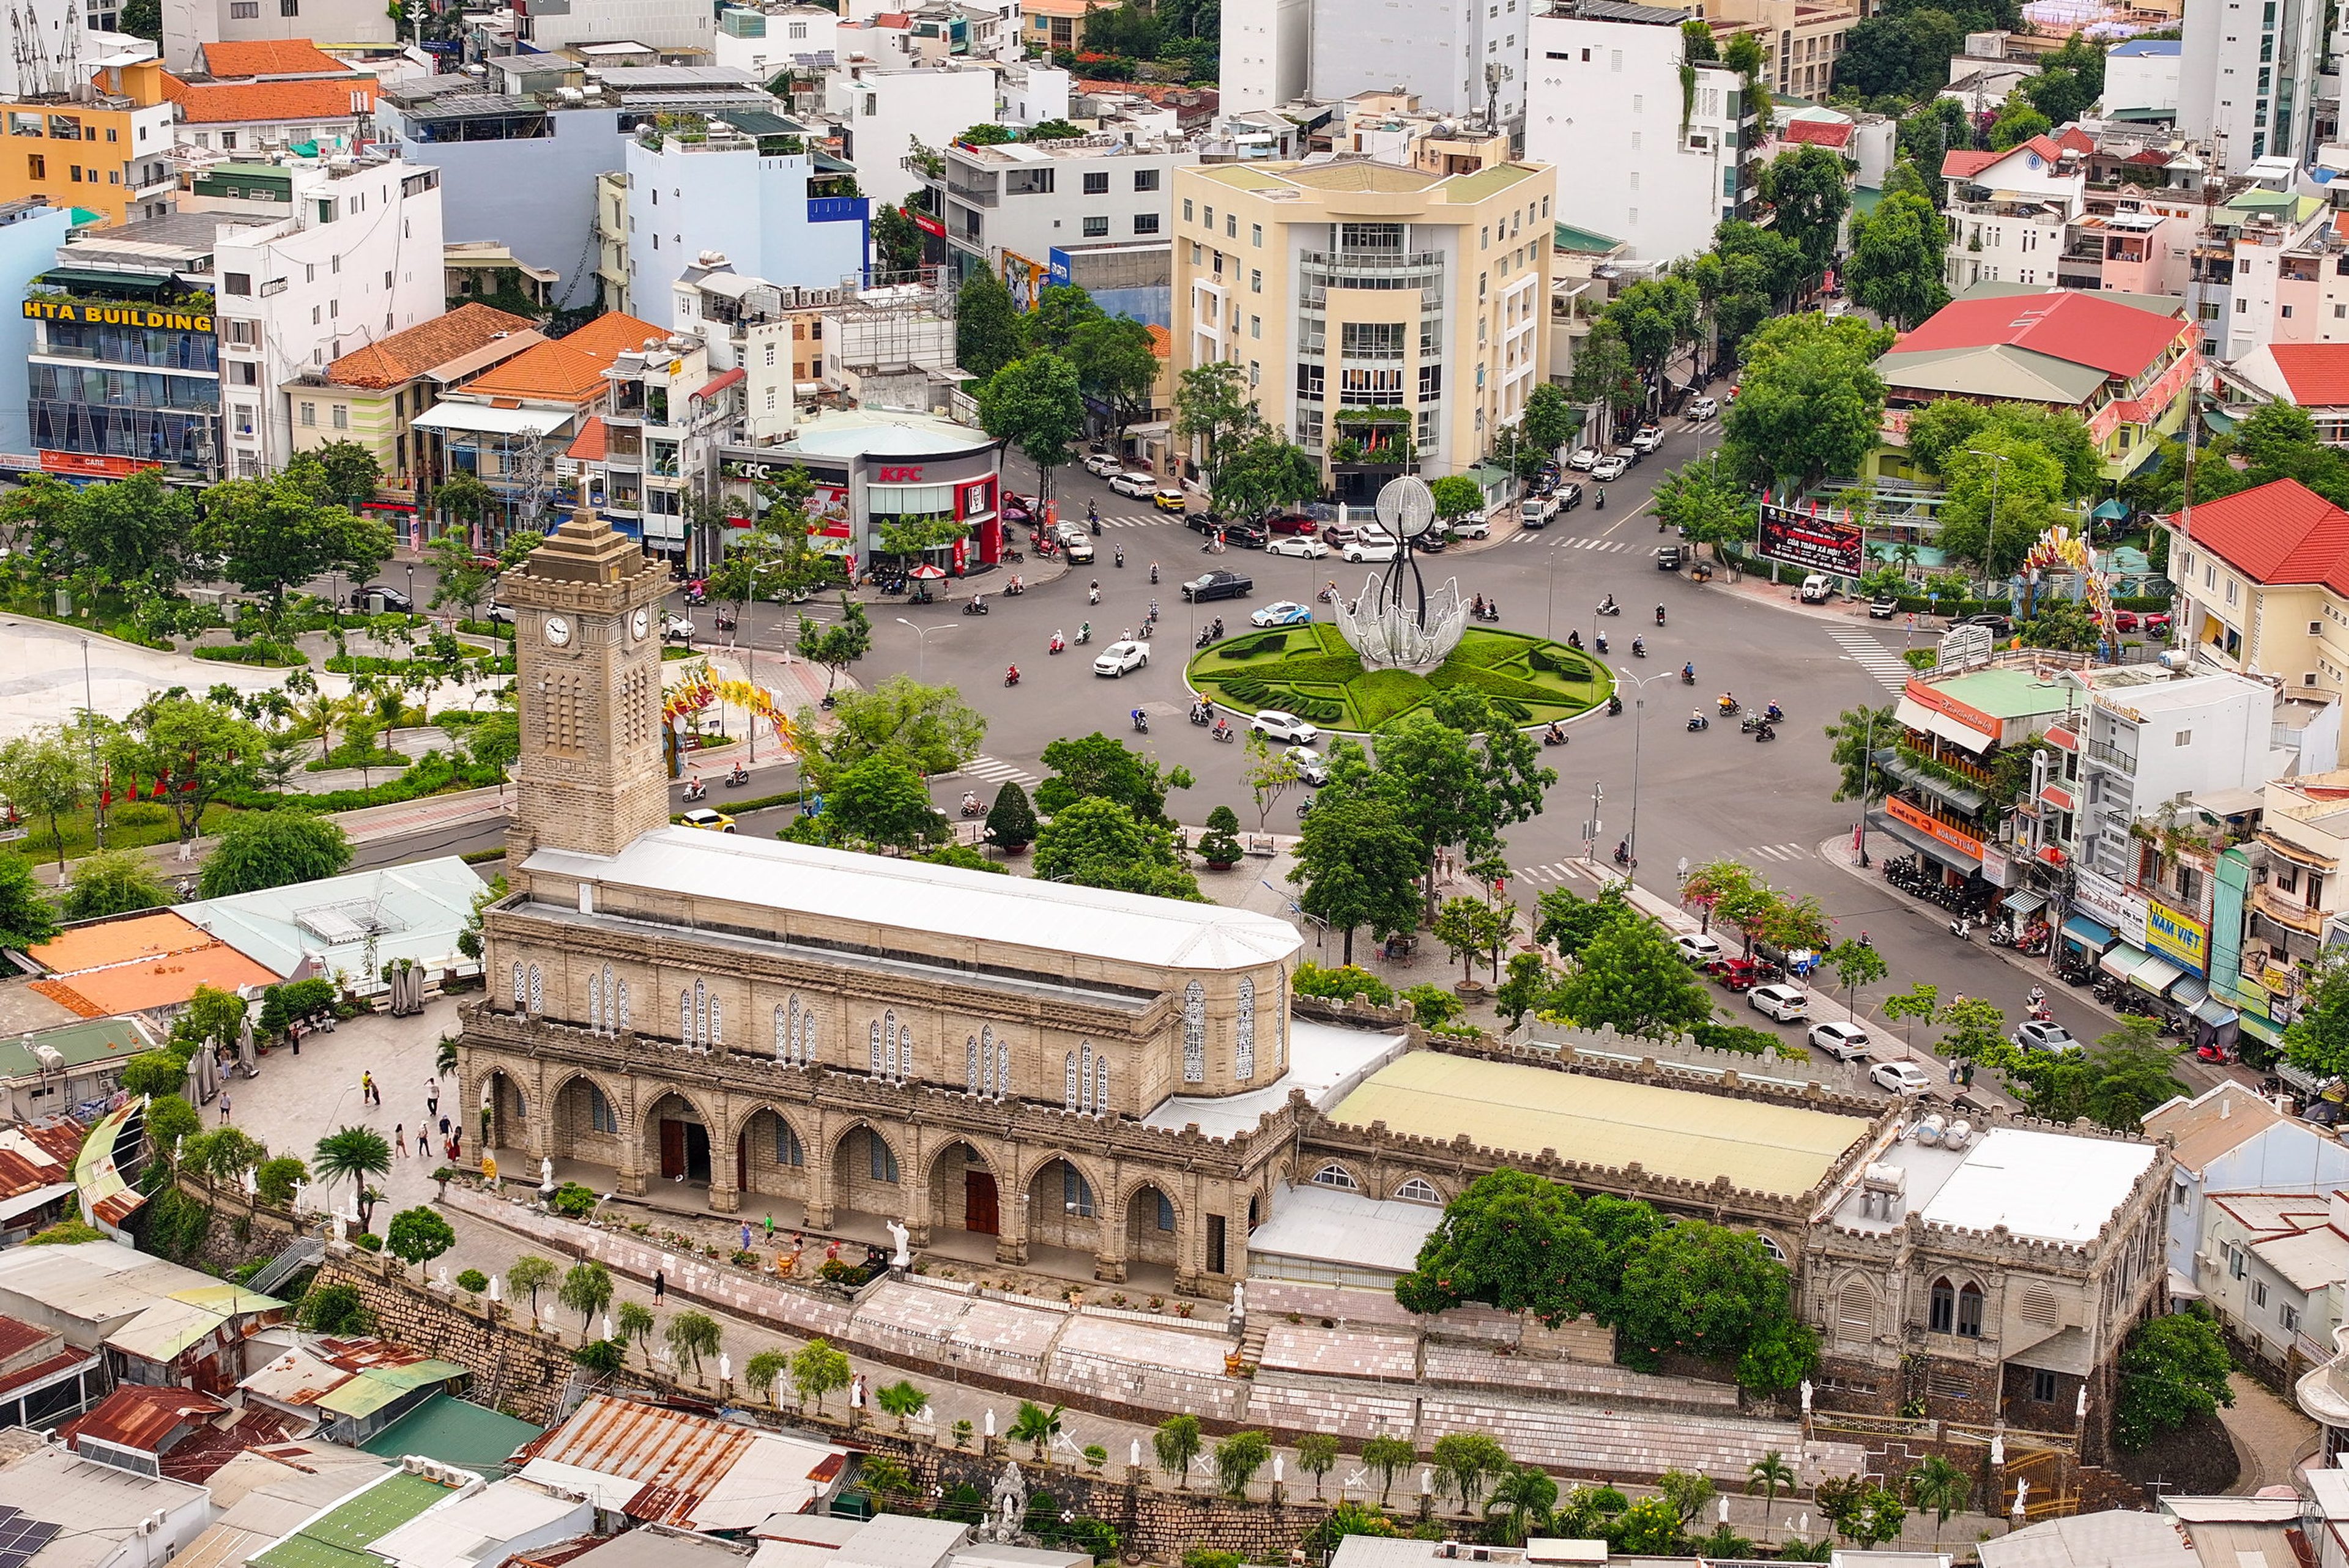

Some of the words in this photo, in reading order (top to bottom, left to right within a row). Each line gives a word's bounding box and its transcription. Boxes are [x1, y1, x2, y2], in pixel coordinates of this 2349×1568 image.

[24, 301, 76, 320] HTA
[85, 306, 212, 332] BUILDING
[85, 458, 105, 467] CARE
[731, 461, 770, 480] KFC
[878, 466, 924, 481] KFC
[1787, 538, 1799, 547] CỦA
[1800, 541, 1816, 551] TOÀN
[1255, 690, 1343, 723] TRANG
[1959, 839, 1977, 855] TUẤN
[2151, 912, 2175, 937] NAM
[2178, 926, 2201, 950] VIỆT
